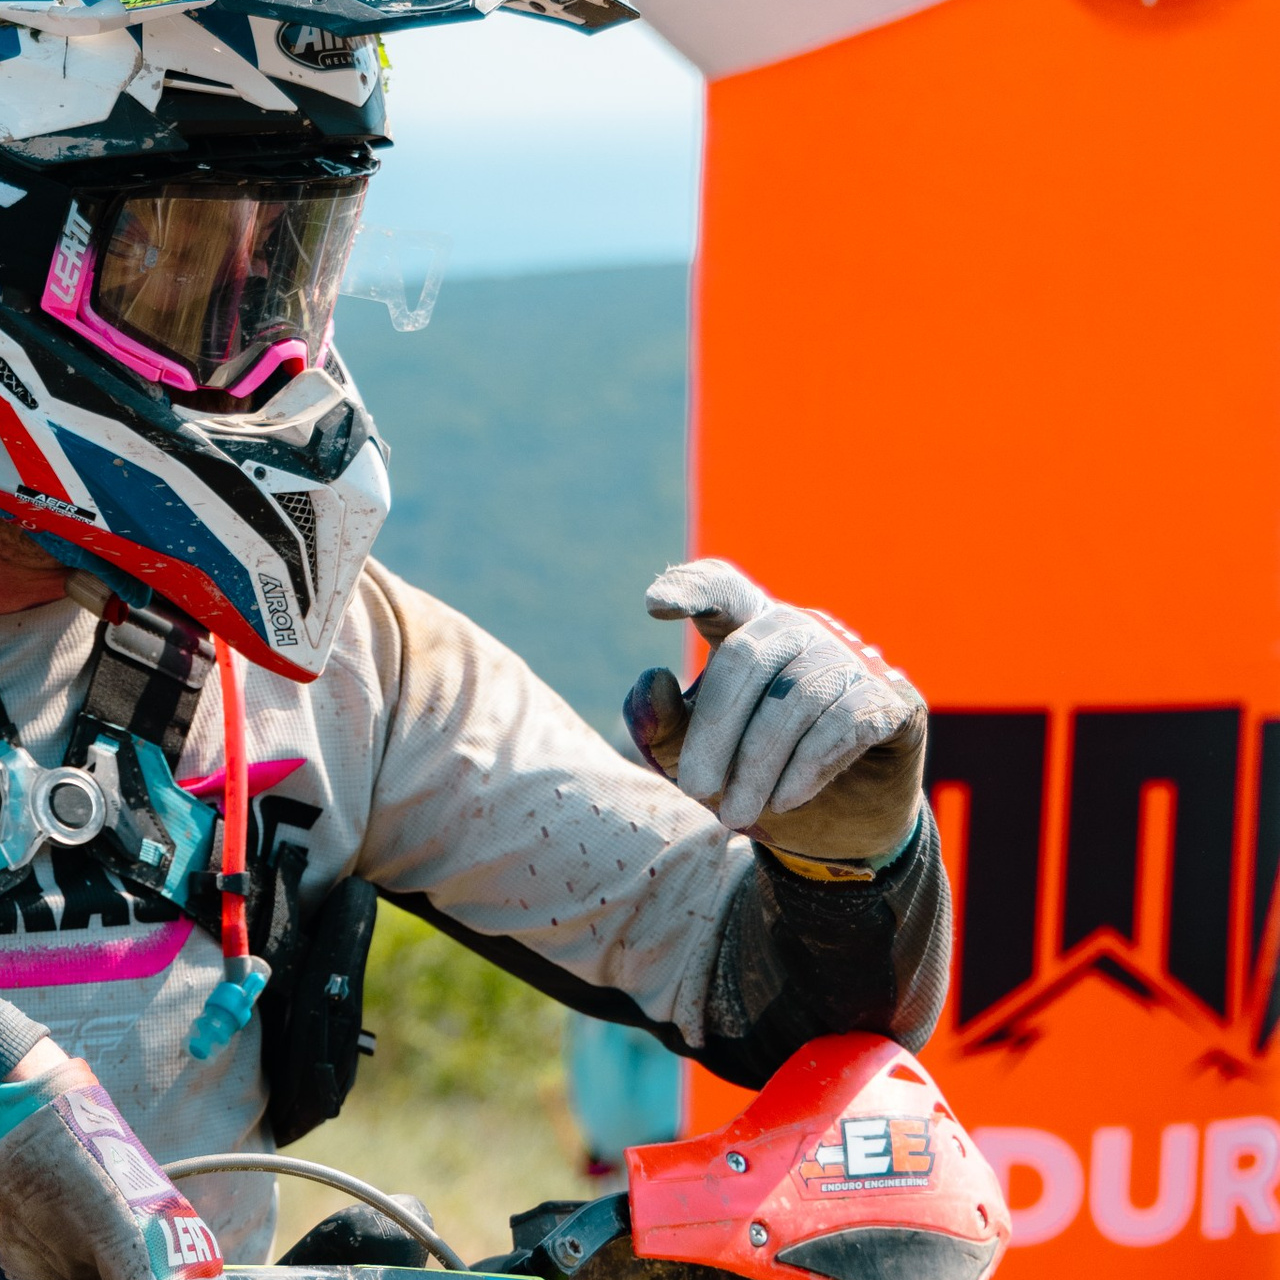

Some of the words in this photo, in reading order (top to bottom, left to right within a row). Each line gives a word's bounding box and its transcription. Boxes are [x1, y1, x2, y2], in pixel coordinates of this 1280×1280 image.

[50, 199, 92, 304] LEATT
[258, 573, 298, 647] AIROH
[821, 1180, 863, 1192] ENDURO
[864, 1178, 929, 1190] ENGINEERING
